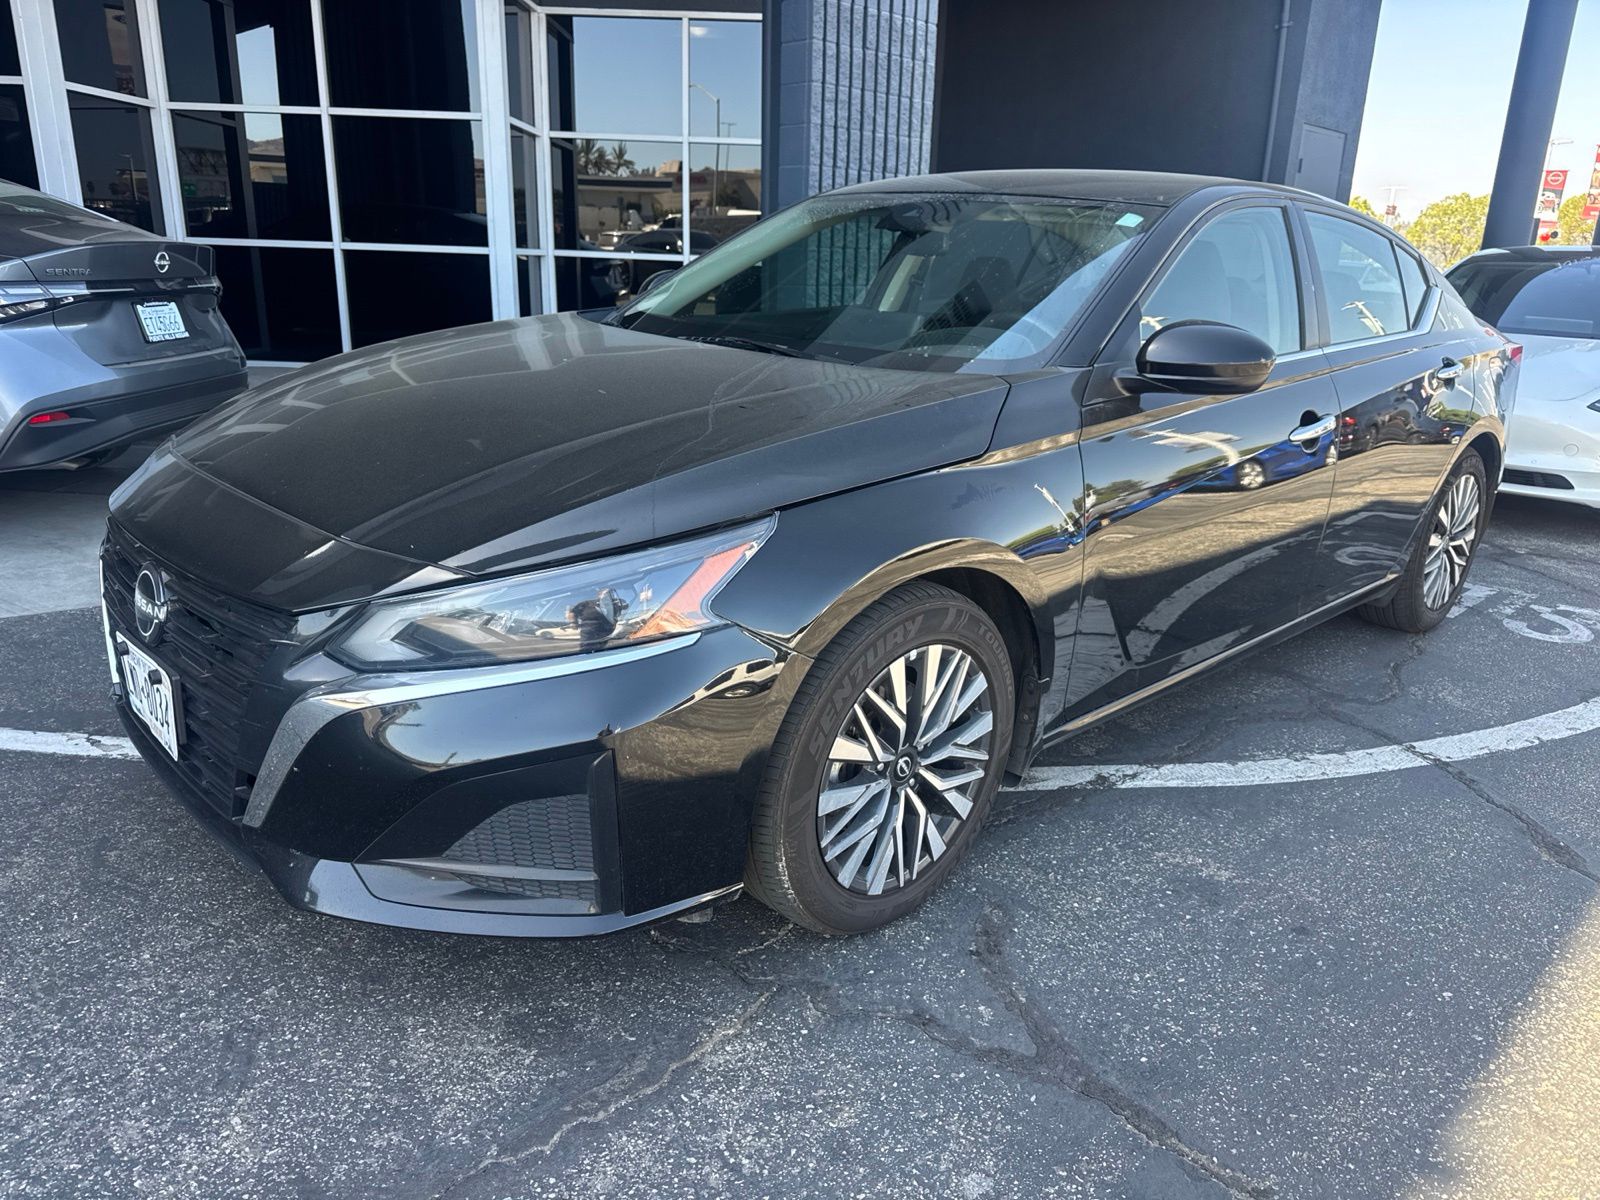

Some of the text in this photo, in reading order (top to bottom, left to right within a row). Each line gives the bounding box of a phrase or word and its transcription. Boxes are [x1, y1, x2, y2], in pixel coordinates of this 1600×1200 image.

[45, 268, 92, 276] SENTRA
[808, 613, 925, 761] SENTURY
[976, 621, 1015, 699] TOURING
